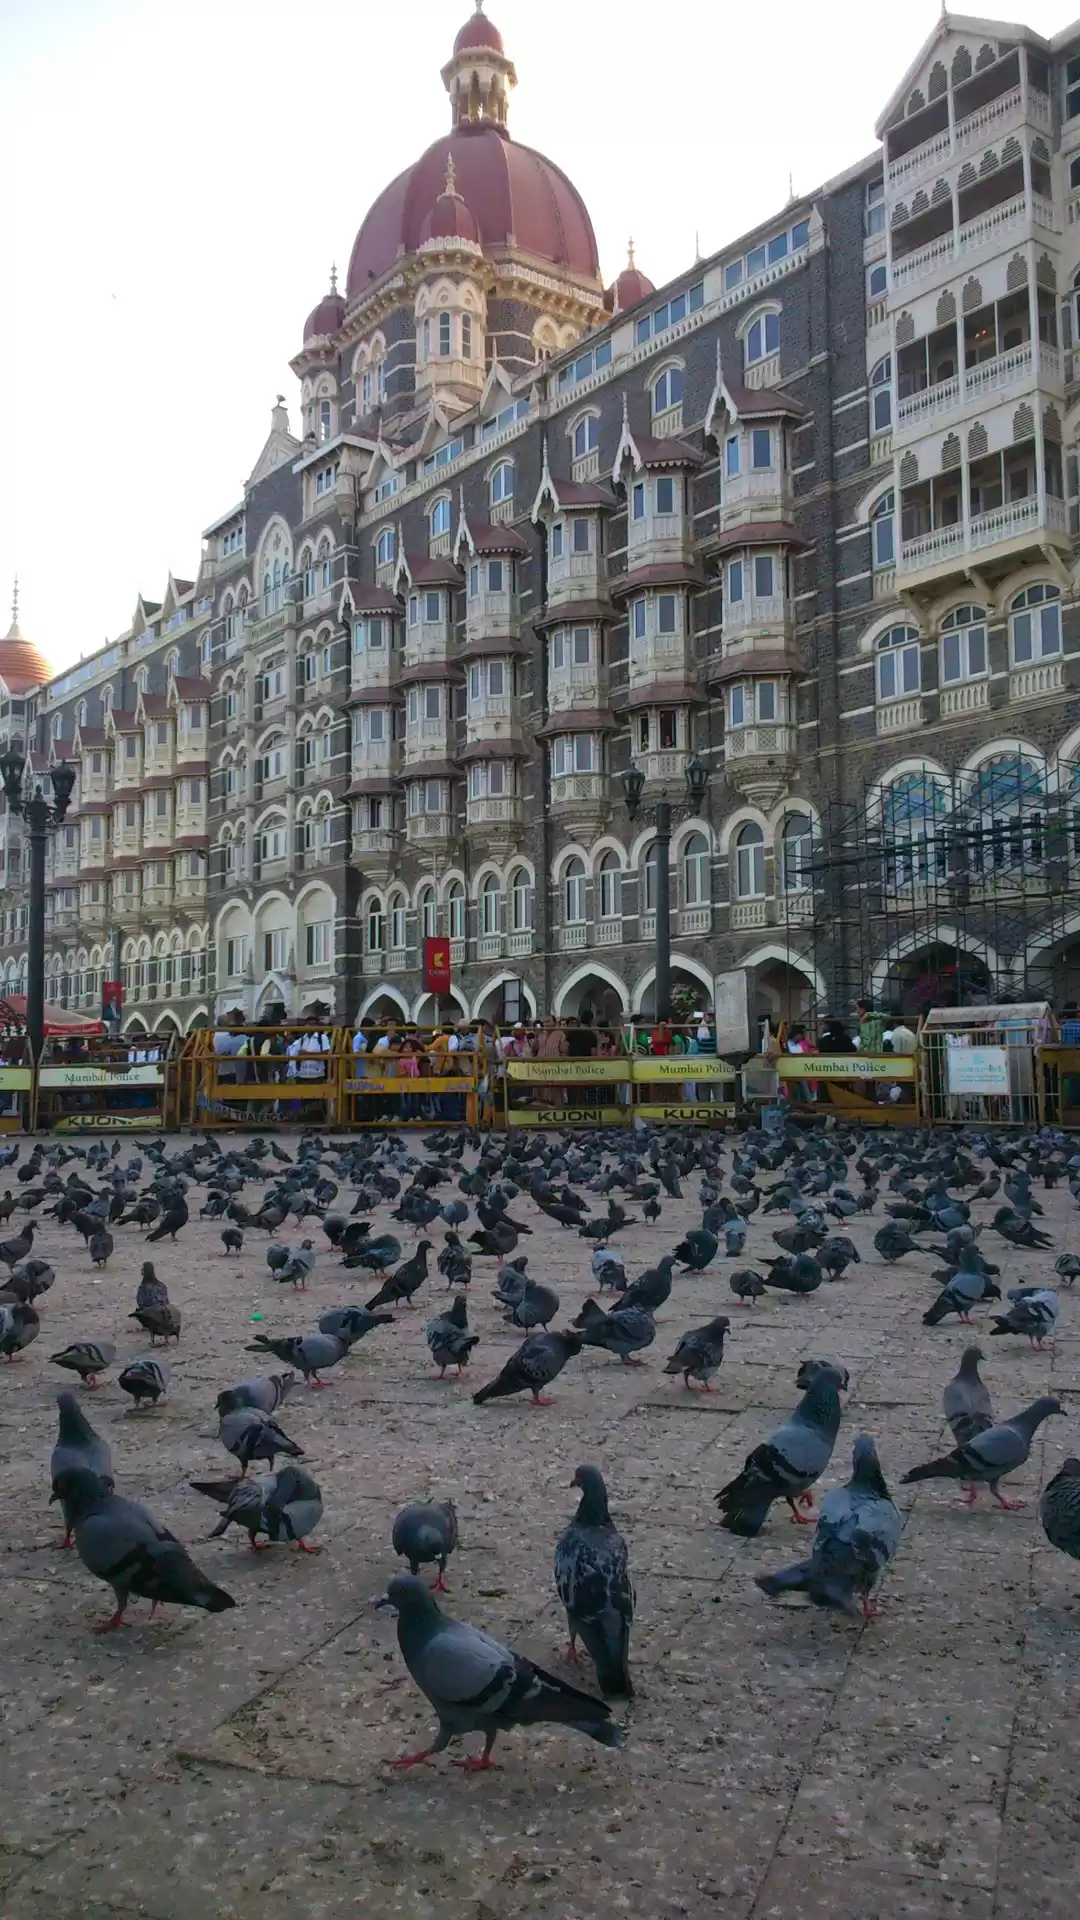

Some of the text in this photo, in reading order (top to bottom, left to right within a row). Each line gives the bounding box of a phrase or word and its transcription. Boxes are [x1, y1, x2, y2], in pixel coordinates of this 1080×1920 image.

[532, 1064, 605, 1075] Mumbai Police
[660, 1063, 703, 1074] Mumbai
[804, 1062, 887, 1073] Mumbai Police
[537, 1111, 603, 1122] KUONI
